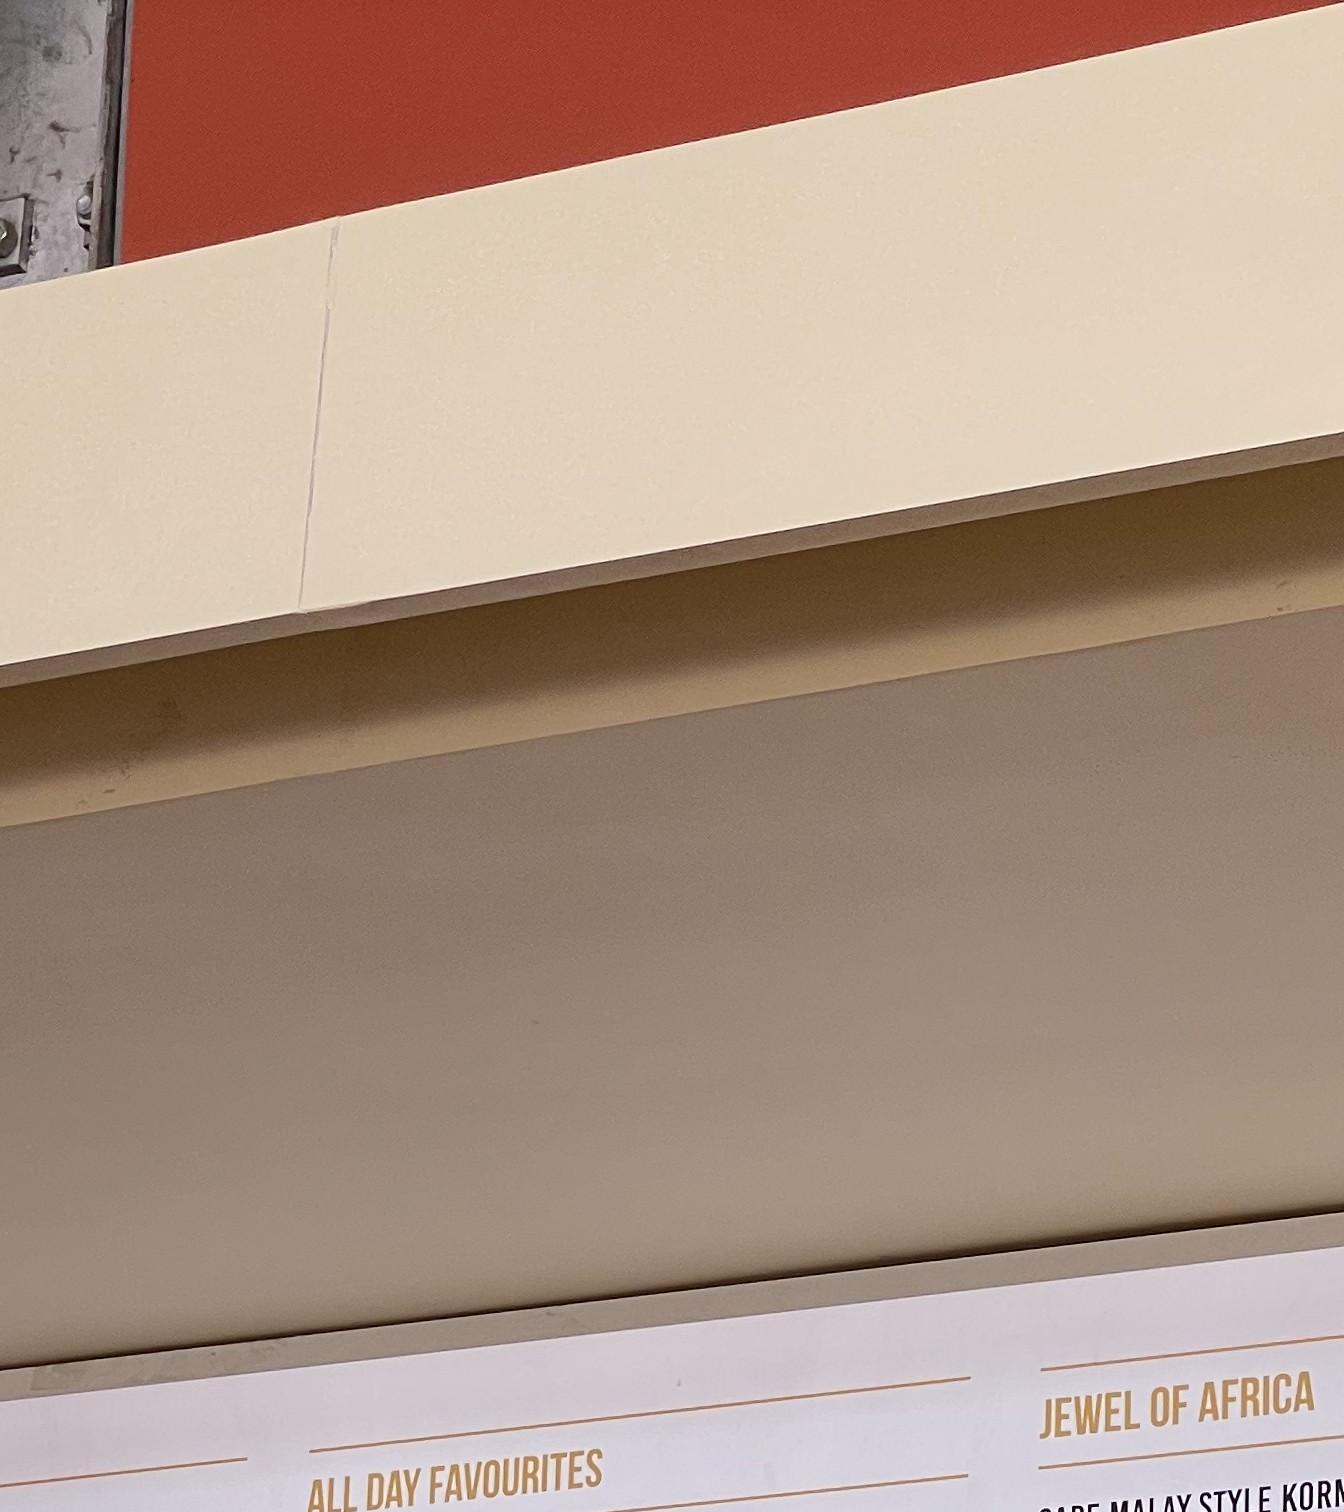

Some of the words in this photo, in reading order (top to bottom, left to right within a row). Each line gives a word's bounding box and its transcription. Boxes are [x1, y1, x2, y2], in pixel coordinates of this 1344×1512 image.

[1039, 1390, 1141, 1440] JEWEL
[1150, 1384, 1190, 1428] OF
[1198, 1370, 1315, 1423] AFRICA
[366, 1467, 422, 1512] DAY
[428, 1448, 604, 1505] FAVOURITES
